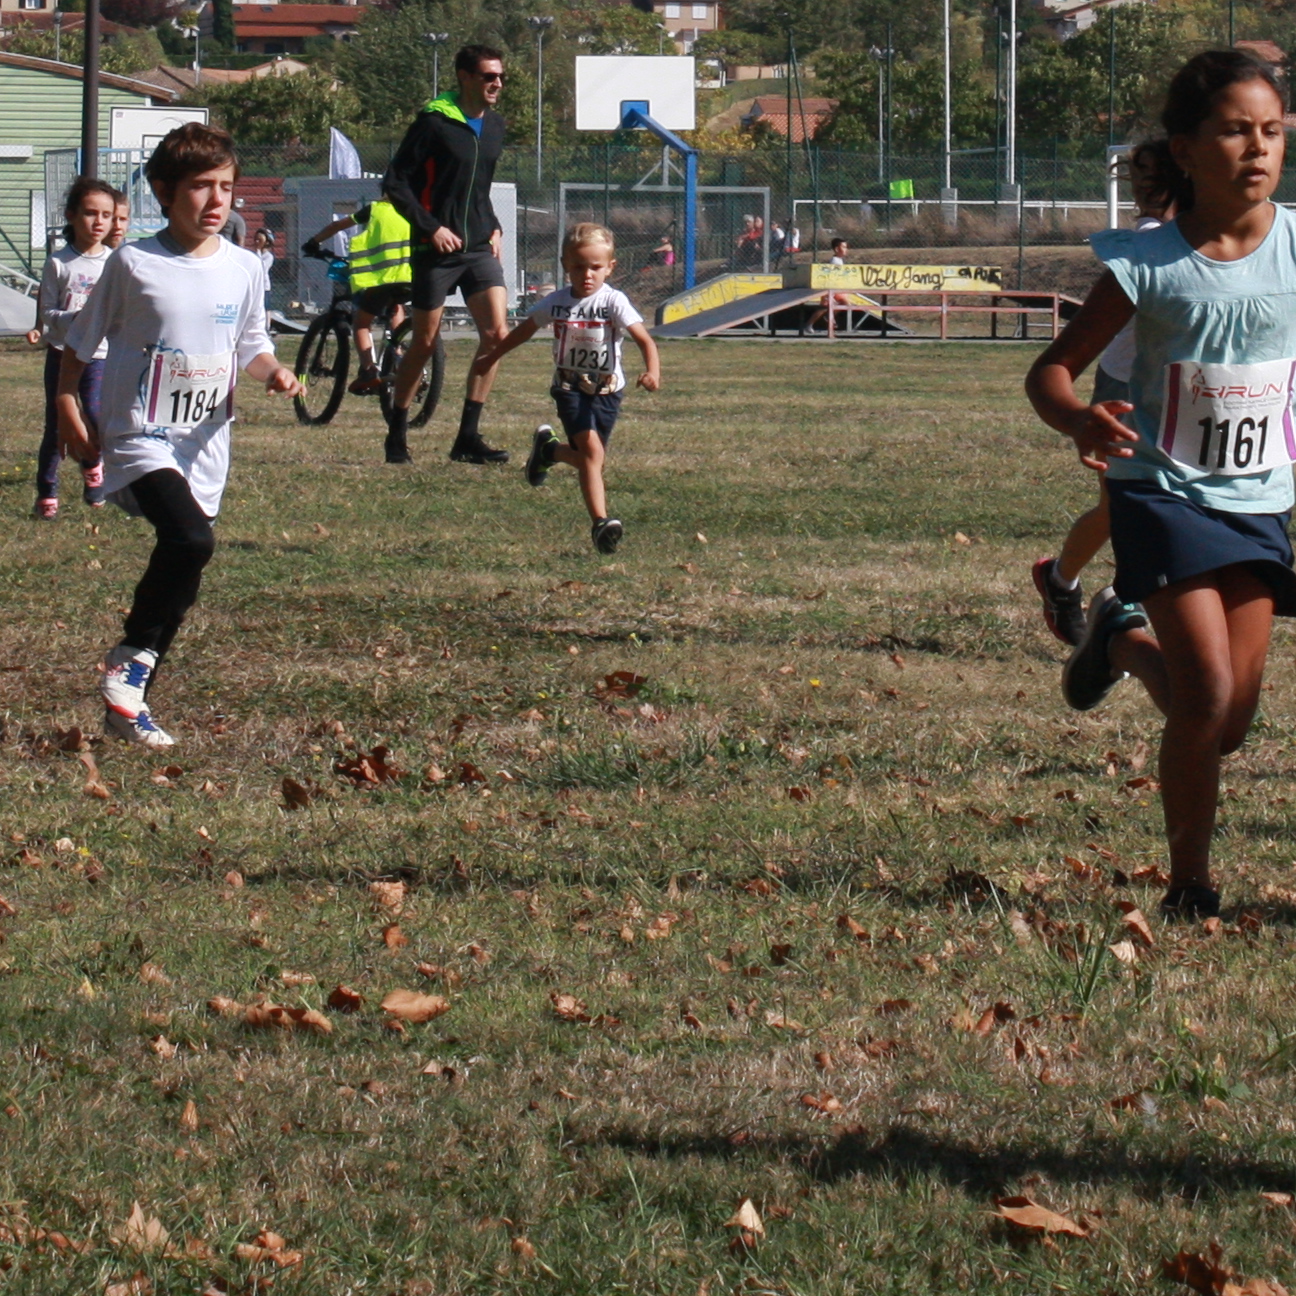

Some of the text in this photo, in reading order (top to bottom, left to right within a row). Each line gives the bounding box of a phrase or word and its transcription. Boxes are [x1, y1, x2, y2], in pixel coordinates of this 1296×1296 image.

[589, 306, 609, 319] ME
[569, 347, 610, 372] 1232
[170, 386, 219, 424] 1184
[1198, 415, 1270, 469] 1161
